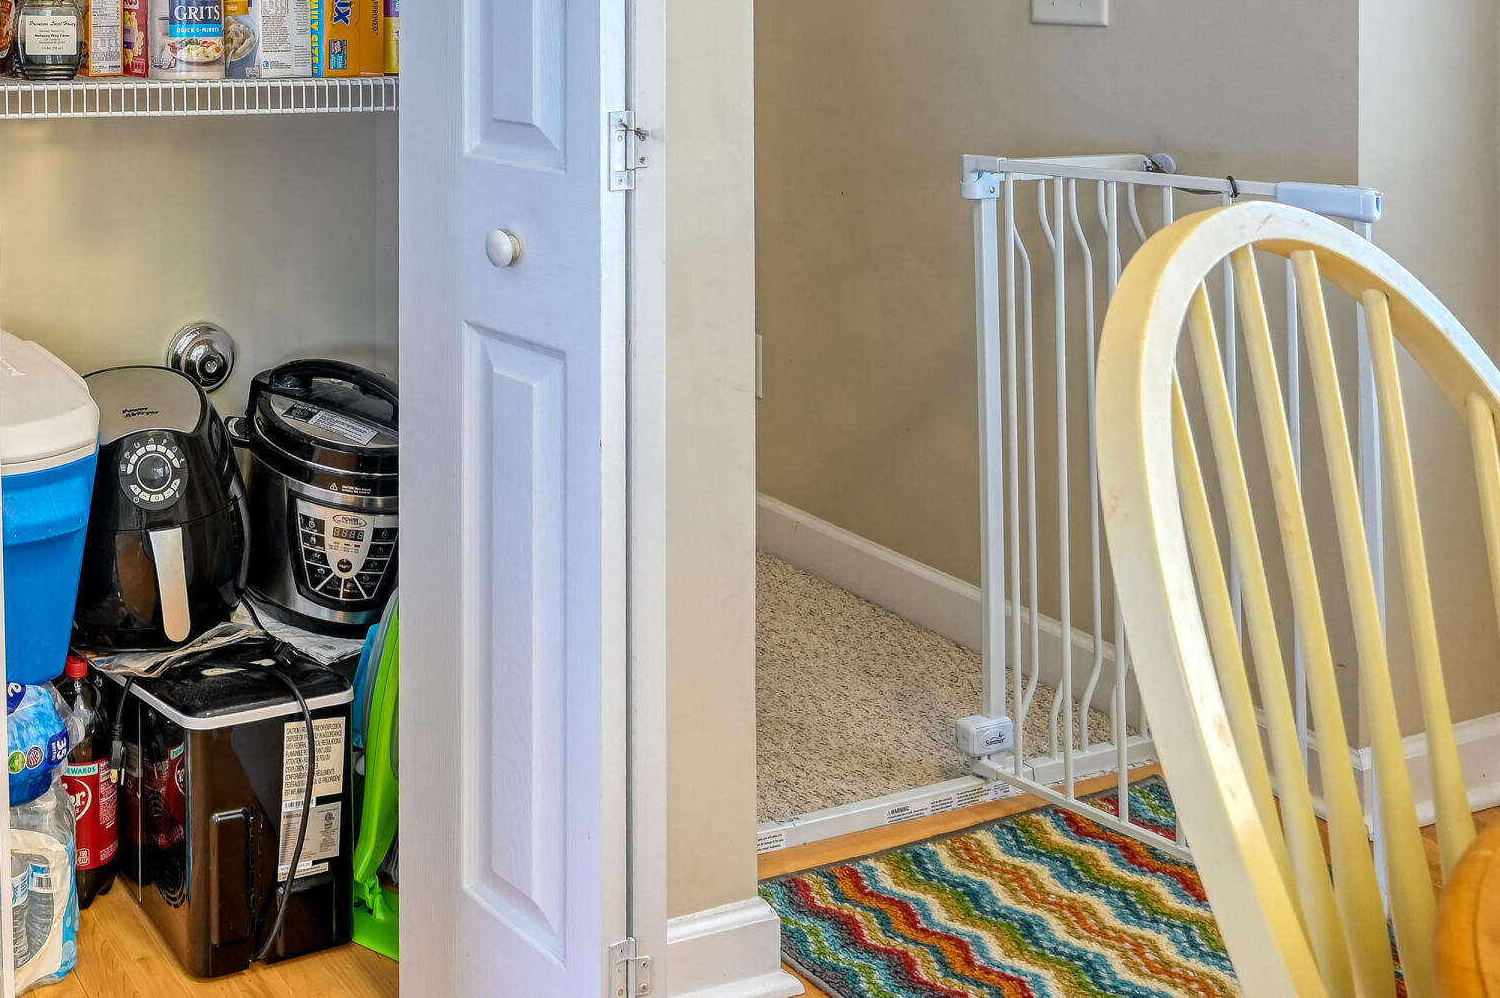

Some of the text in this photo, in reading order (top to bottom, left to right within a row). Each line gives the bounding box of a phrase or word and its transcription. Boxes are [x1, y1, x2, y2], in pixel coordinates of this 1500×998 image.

[174, 5, 220, 21] GRITS
[286, 726, 299, 734] CAUTION
[985, 738, 1005, 746] Summer
[57, 737, 67, 760] 35
[67, 766, 96, 775] EWARDS
